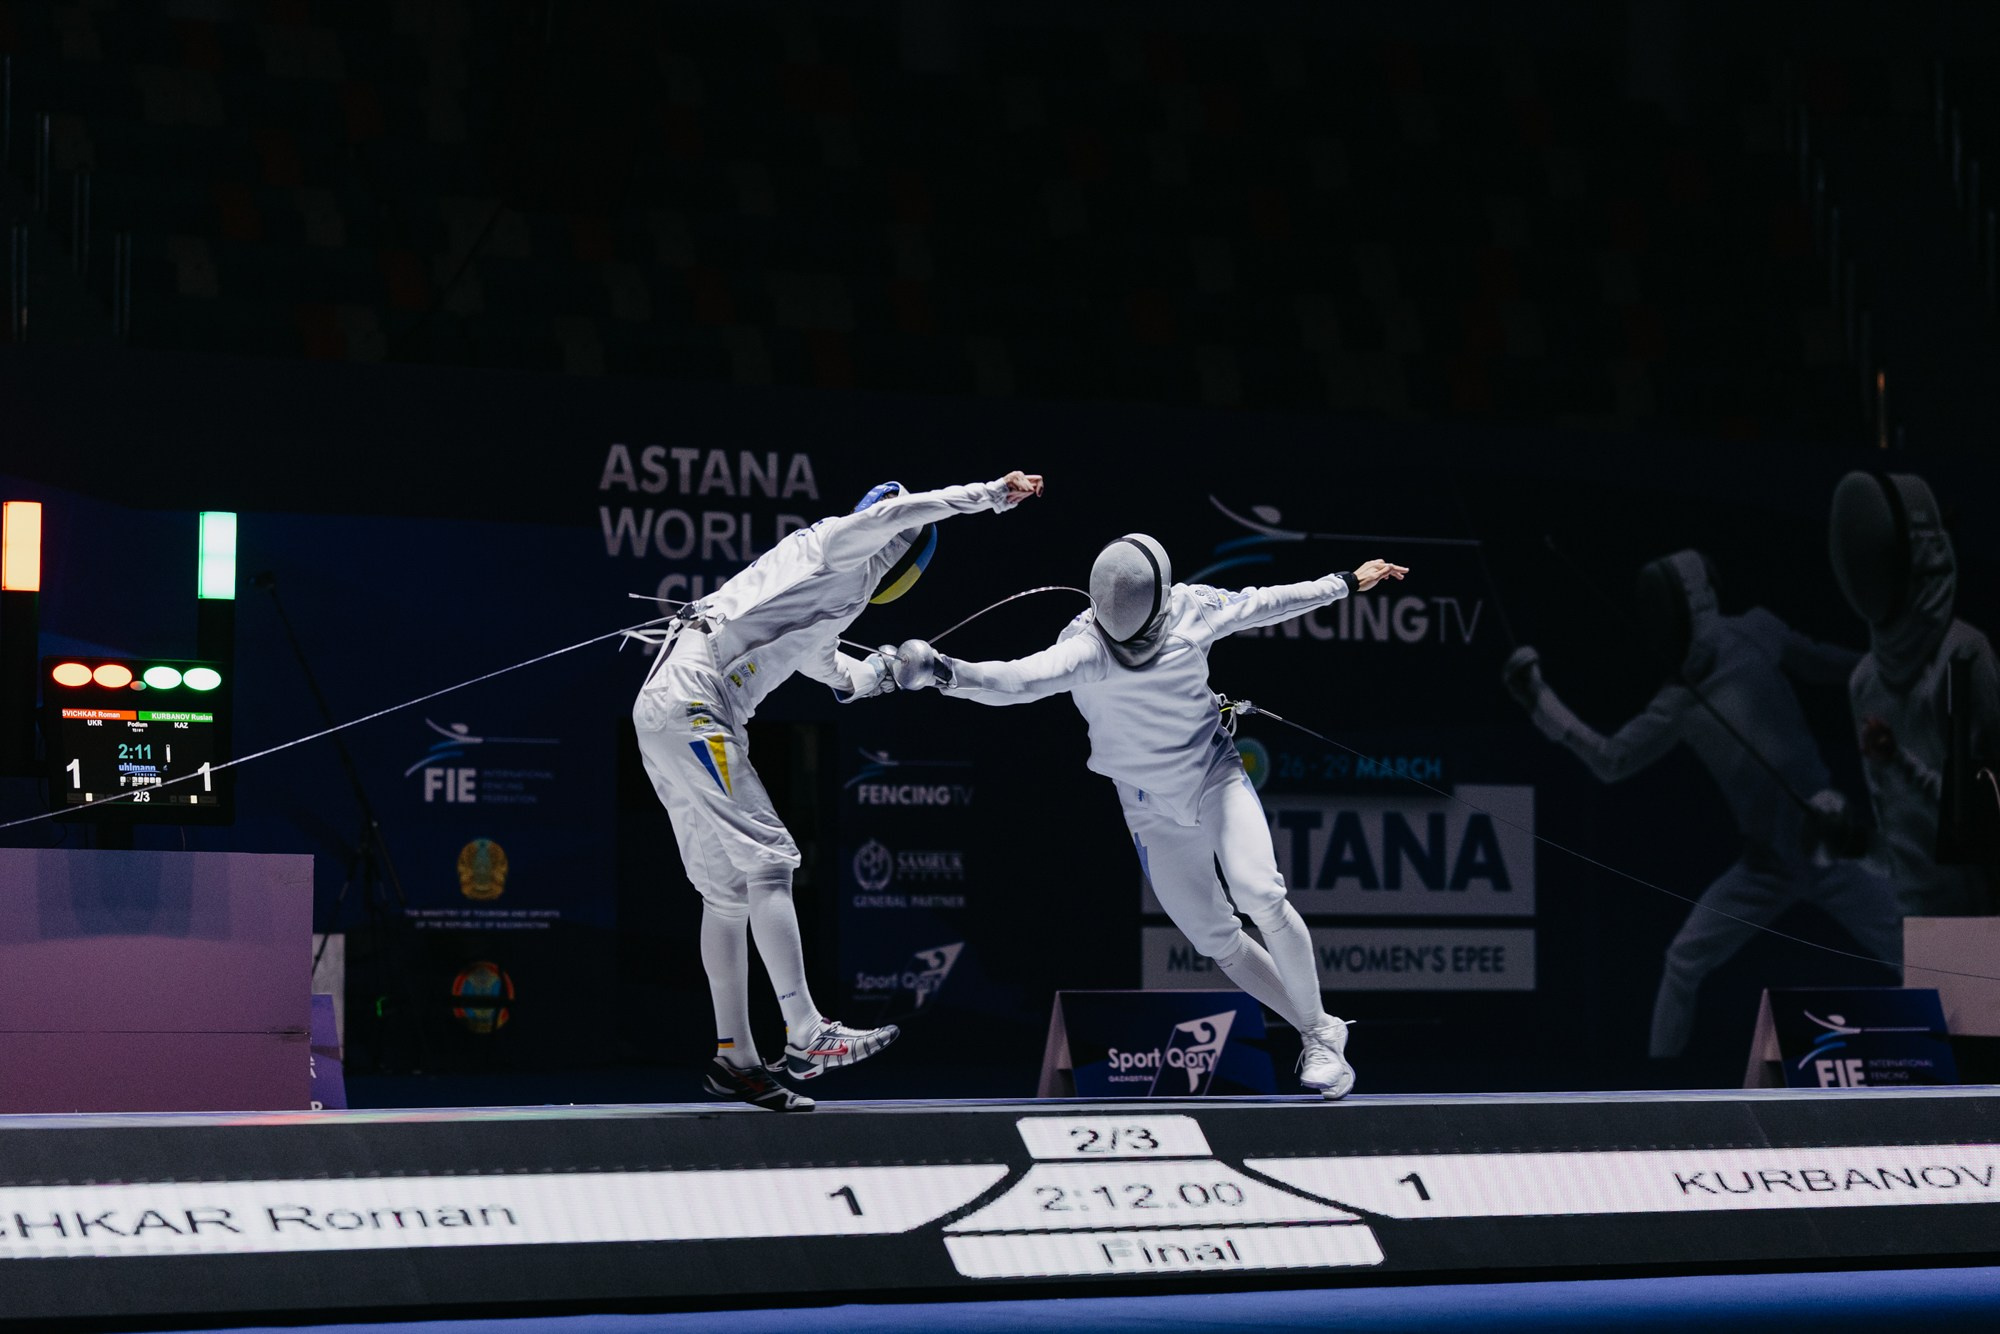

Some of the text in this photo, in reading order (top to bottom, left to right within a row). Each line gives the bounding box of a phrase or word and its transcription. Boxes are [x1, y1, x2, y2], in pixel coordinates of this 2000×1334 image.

[598, 443, 820, 500] ASTANA
[62, 709, 97, 717] SVICHKAR
[118, 744, 151, 759] 2:11
[66, 759, 81, 789] 1
[118, 763, 156, 771] uhlmann
[197, 762, 212, 791] 1
[1355, 756, 1442, 781] MARCH
[133, 791, 151, 802] 2/3
[424, 767, 477, 803] FIE
[1266, 810, 1512, 891] TANA
[1320, 945, 1446, 972] WOMEN'S
[1453, 946, 1505, 972] EPEE
[1108, 1047, 1161, 1073] Sport
[1815, 1058, 1868, 1088] FIE
[1069, 1125, 1159, 1152] 2/3
[1398, 1172, 1431, 1201] 1
[1673, 1164, 1995, 1195] KURBANOV
[828, 1185, 864, 1216] 1
[1035, 1182, 1245, 1213] 2:12.00
[0, 1204, 516, 1238] HKAR Roman
[1097, 1235, 1241, 1267] Final
